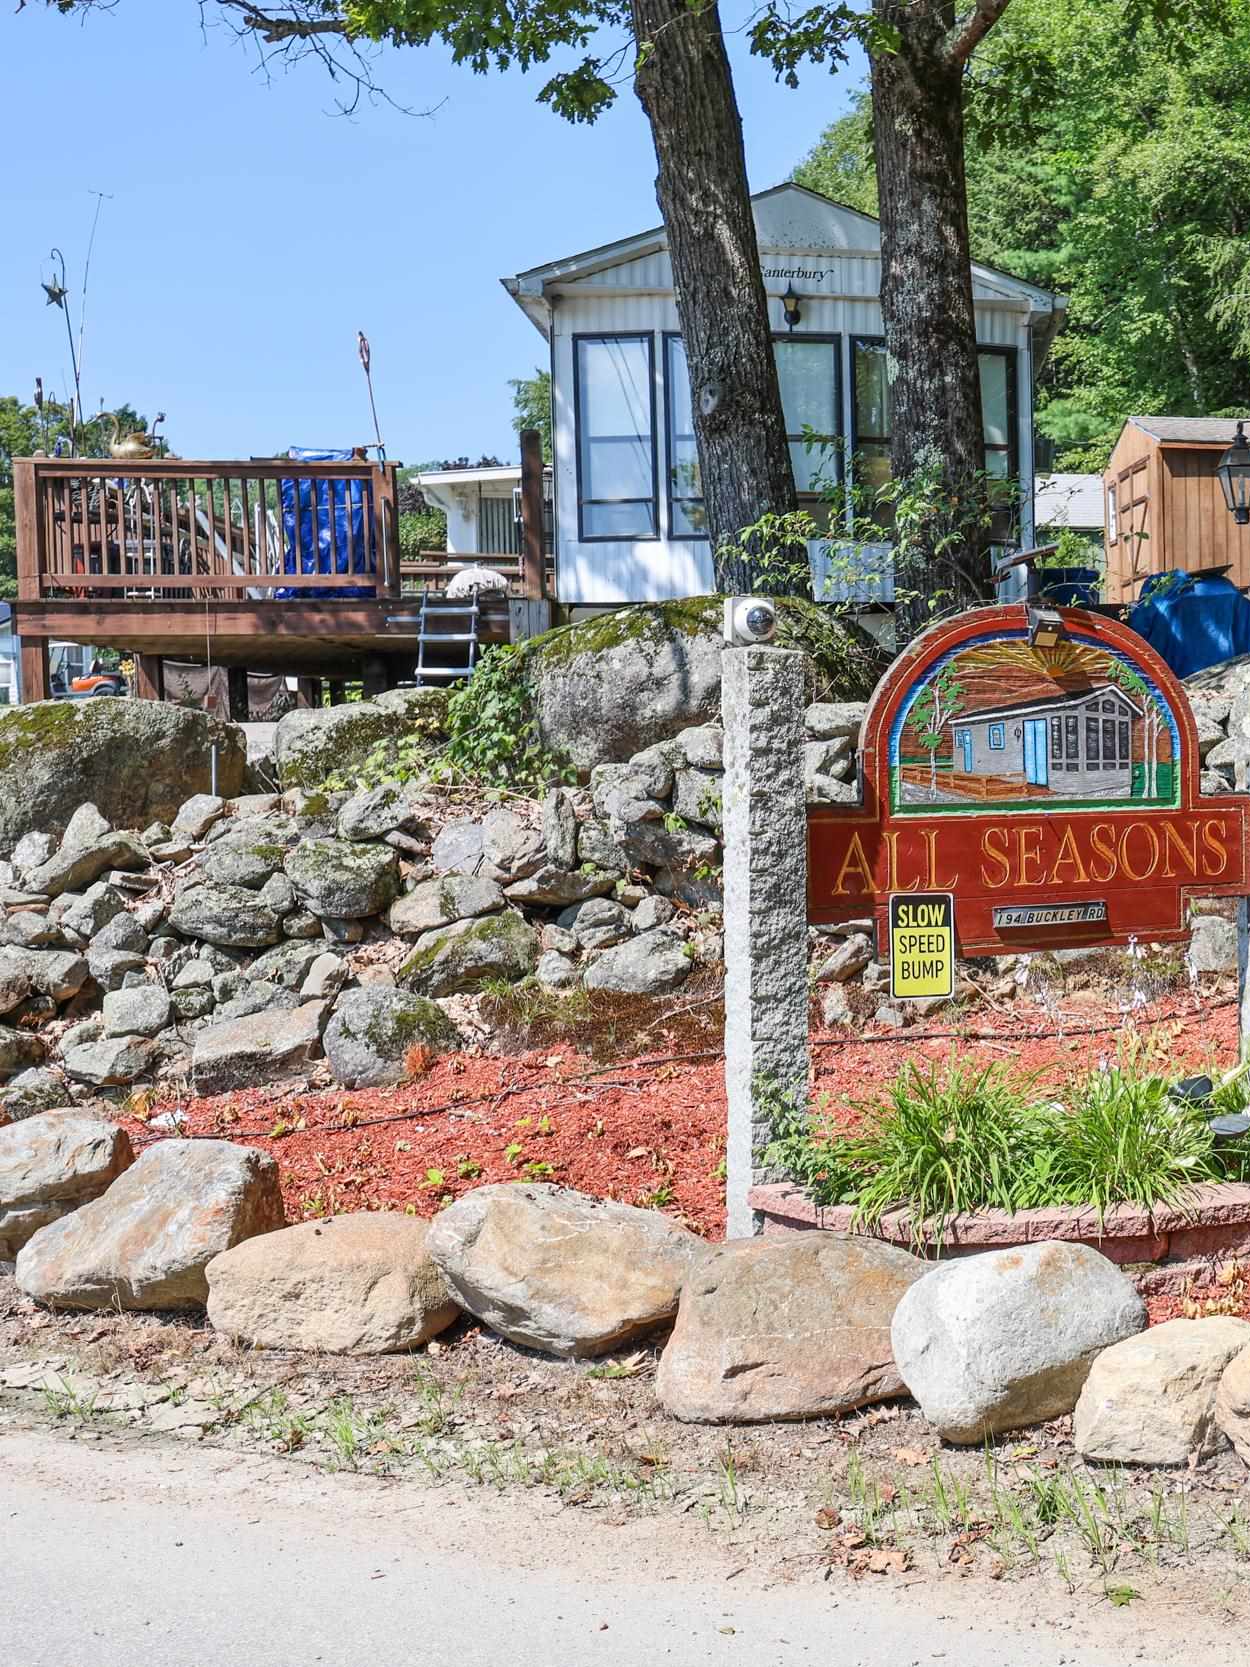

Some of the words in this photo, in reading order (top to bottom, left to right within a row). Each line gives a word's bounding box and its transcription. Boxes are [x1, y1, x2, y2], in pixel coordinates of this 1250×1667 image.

[832, 830, 959, 895] ALL
[980, 819, 1227, 888] SEASONS
[897, 904, 946, 927] SLOW
[998, 913, 1021, 925] 194
[1027, 910, 1083, 923] BUCKLEY
[1088, 908, 1103, 920] RD
[899, 934, 945, 954] SPEED
[901, 960, 944, 980] BUMP
